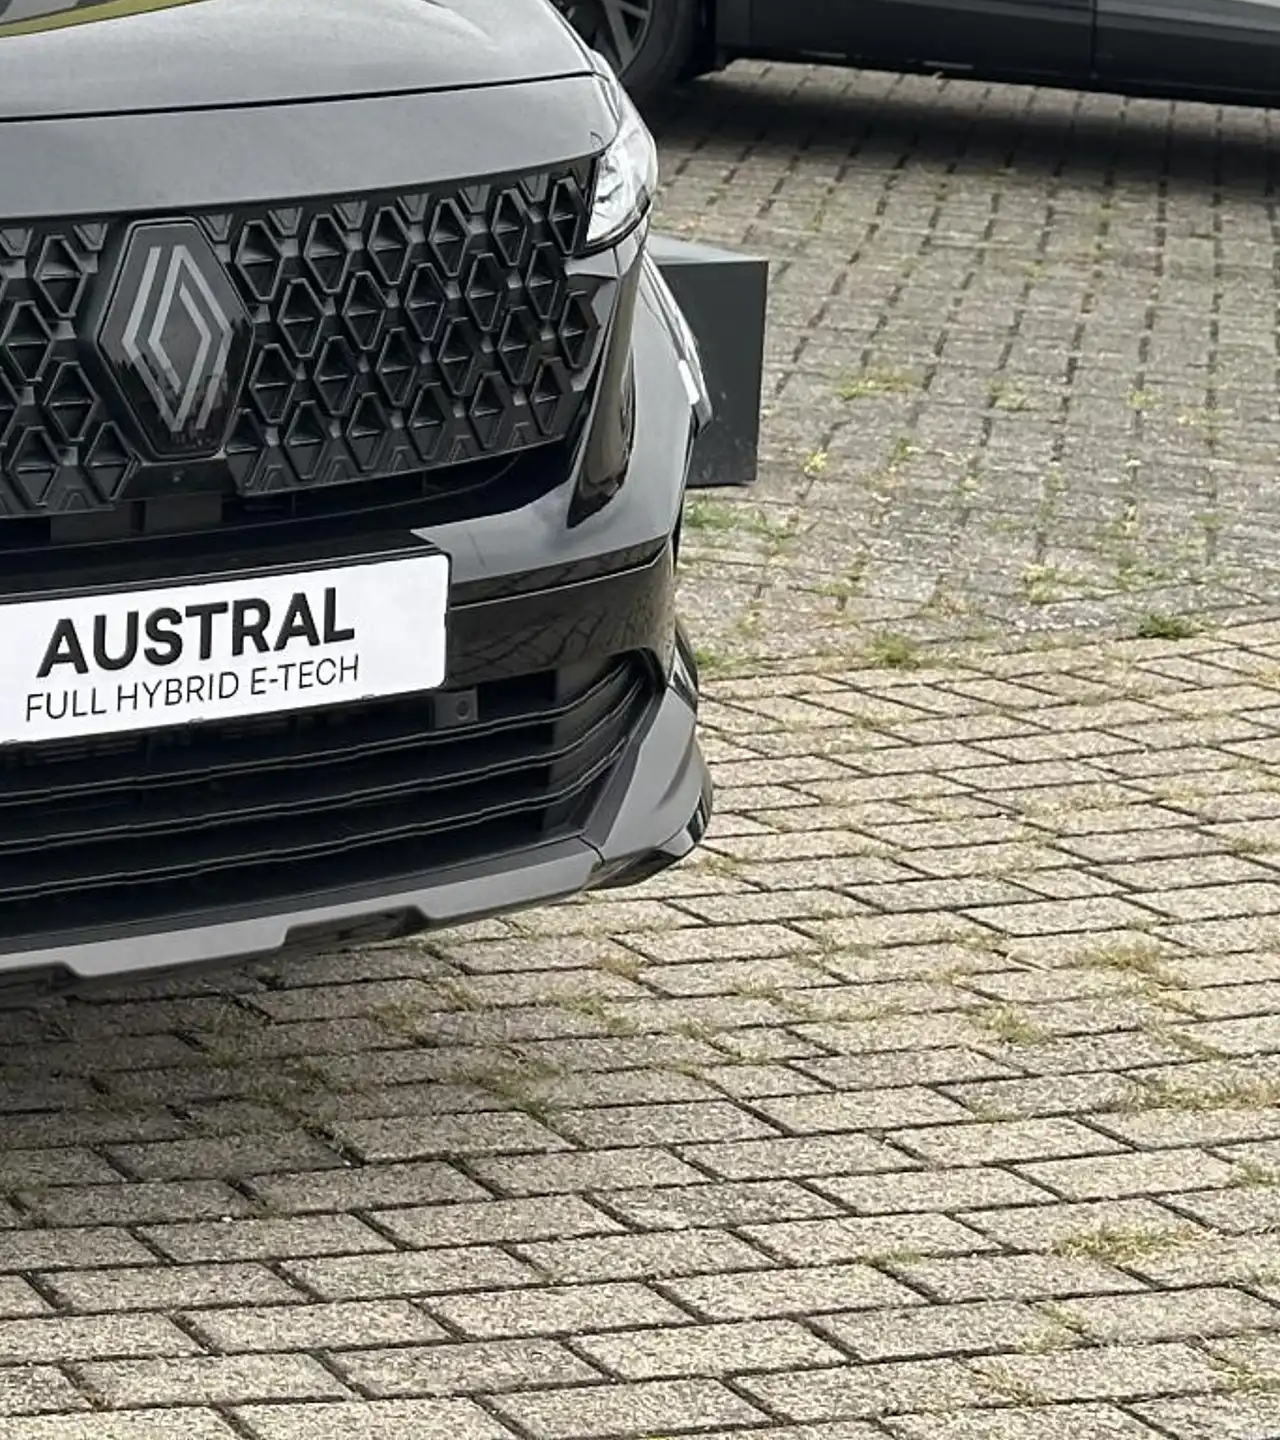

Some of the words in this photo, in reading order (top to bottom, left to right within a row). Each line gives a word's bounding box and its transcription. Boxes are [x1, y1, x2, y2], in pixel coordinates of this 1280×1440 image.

[37, 587, 355, 678] AUSTRAL
[25, 685, 107, 722] FULL
[117, 672, 239, 712] HYBRID
[250, 655, 359, 695] E-TECH
